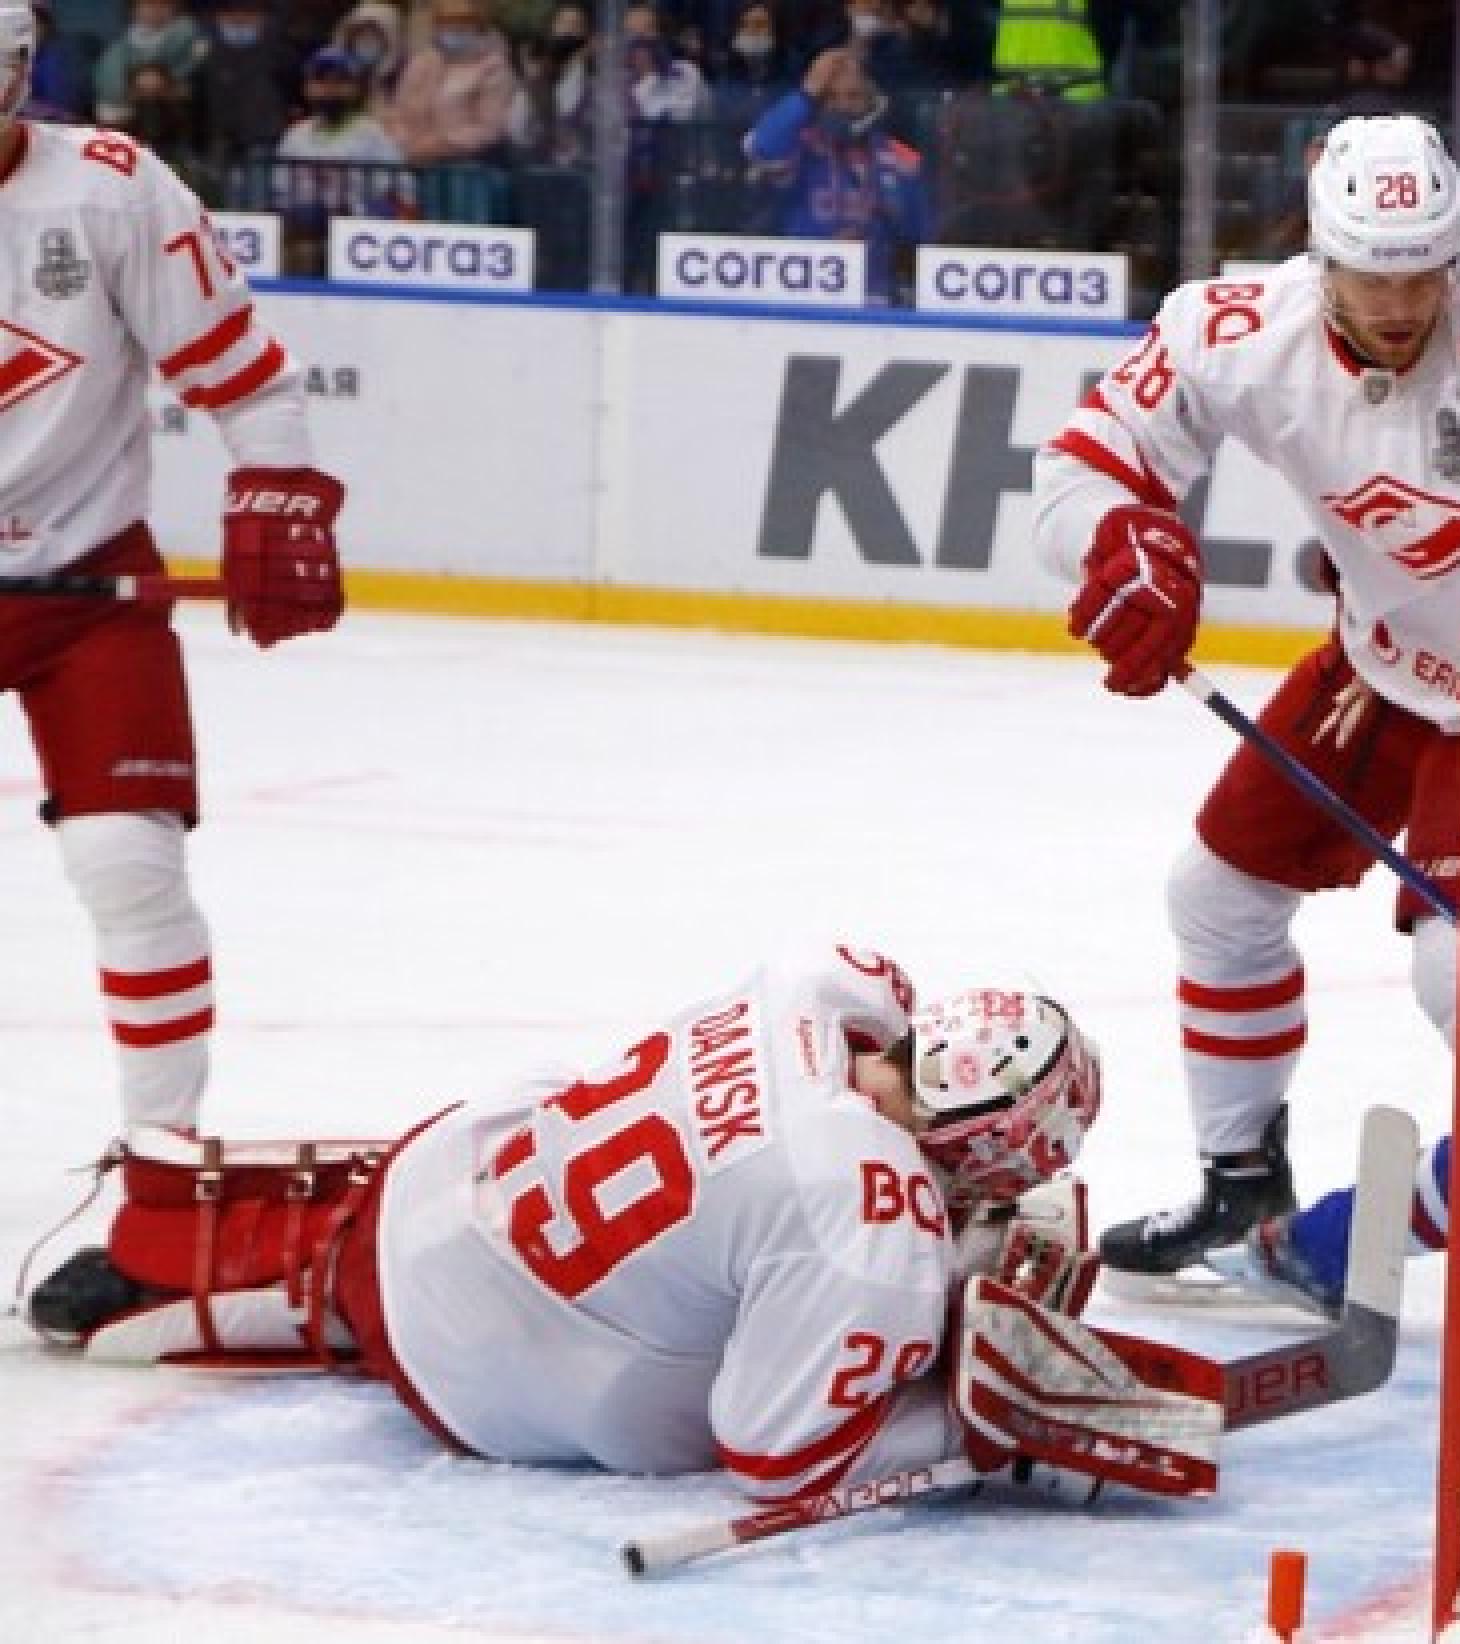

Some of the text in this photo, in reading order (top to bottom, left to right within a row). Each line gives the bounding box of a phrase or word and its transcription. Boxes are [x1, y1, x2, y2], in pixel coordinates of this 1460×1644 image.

[1374, 171, 1421, 211] 28
[691, 999, 764, 1161] DANSK
[492, 1031, 696, 1302] 29
